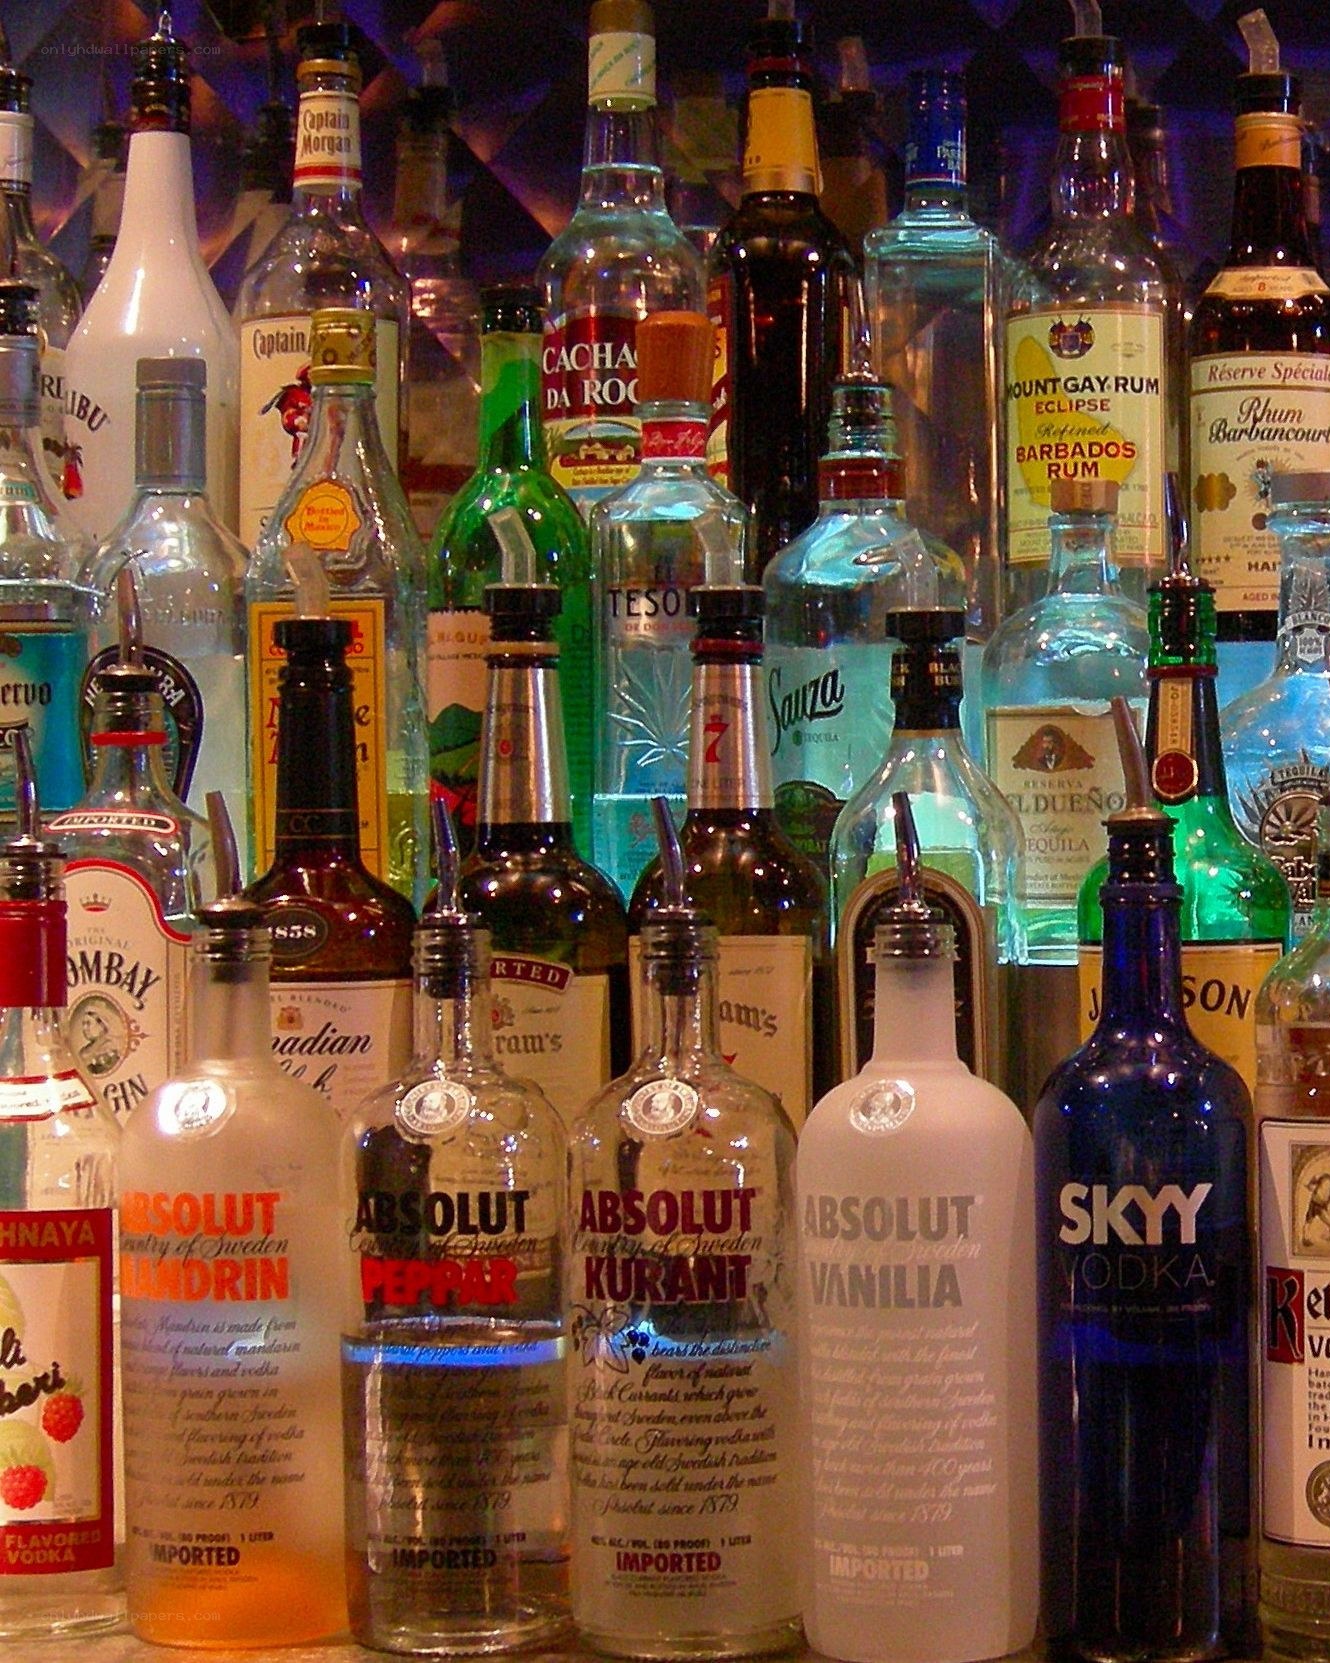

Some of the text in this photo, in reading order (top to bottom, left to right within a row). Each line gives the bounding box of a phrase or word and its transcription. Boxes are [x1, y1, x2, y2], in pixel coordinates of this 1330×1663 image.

[302, 108, 350, 132] Captain
[300, 133, 352, 156] Morgan
[253, 327, 307, 359] Captain
[542, 343, 638, 374] CACHA
[1207, 361, 1266, 382] Réserve
[547, 377, 638, 409] DA ROC
[1064, 377, 1110, 395] GAY
[1114, 375, 1160, 396] RUM
[65, 390, 107, 432] LIBU
[1034, 398, 1111, 415] ECLIPSE
[1237, 396, 1304, 426] Rhum
[1035, 422, 1112, 440] Refined
[1016, 441, 1136, 463] BARBADOS
[1047, 461, 1099, 481] RUM
[1247, 561, 1281, 573] HAI
[608, 588, 690, 617] TESO
[0, 681, 52, 707] ervo
[769, 666, 845, 757] Sauza
[704, 720, 729, 763] 7
[1023, 779, 1084, 790] RESERVA
[268, 924, 317, 939] 1858
[67, 950, 161, 1011] OMBAY
[490, 958, 563, 985] RTED
[1089, 979, 1251, 1022] JSON
[272, 1021, 373, 1057] adian
[494, 1030, 563, 1056] ram's
[103, 1073, 149, 1113] GIN
[356, 1189, 530, 1236] ABSOLUT
[579, 1188, 757, 1236] ABSOLUT
[803, 1193, 976, 1242] ABSOLUT
[1058, 1182, 1214, 1246] SKYY
[0, 1219, 96, 1248] HNAYA
[202, 1231, 290, 1258] Sweden
[677, 1230, 763, 1259] Sweden
[361, 1256, 519, 1307] PEPPAR
[584, 1254, 753, 1303] KURANT
[809, 1261, 963, 1309] VANILIA
[1062, 1252, 1211, 1291] VODKA
[1307, 1401, 1327, 1412] the
[1307, 1412, 1322, 1423] in
[5, 1530, 100, 1549] FLAVORED
[6, 1550, 76, 1566] VODKA
[616, 1551, 722, 1573] IMPORTED
[829, 1554, 930, 1581] IMPORTED
